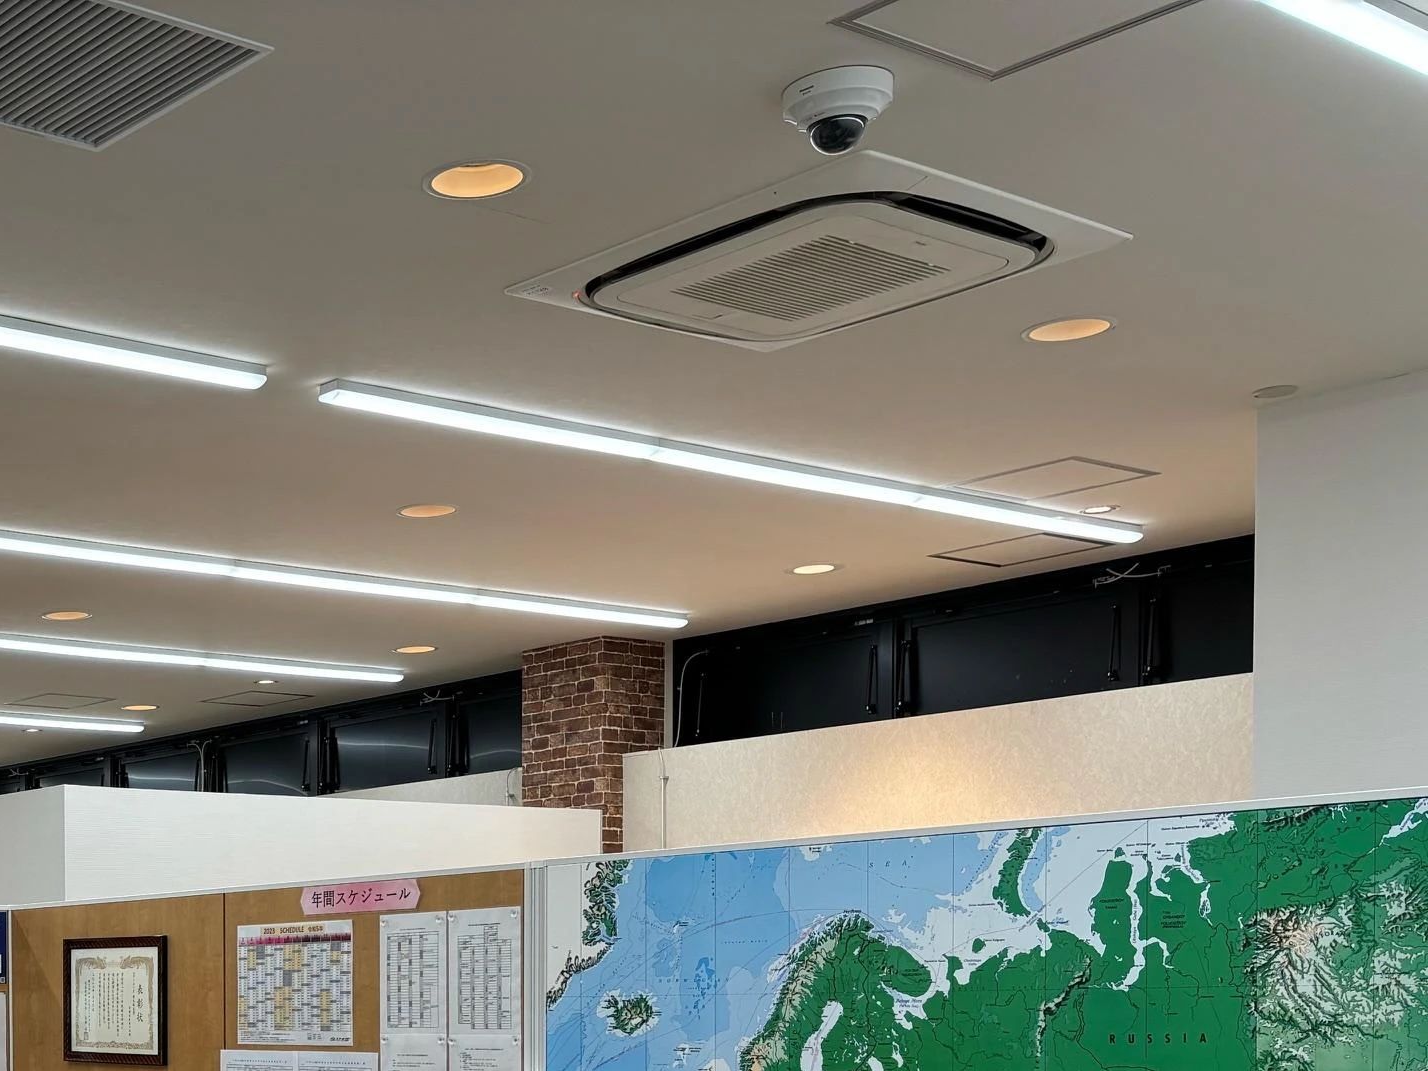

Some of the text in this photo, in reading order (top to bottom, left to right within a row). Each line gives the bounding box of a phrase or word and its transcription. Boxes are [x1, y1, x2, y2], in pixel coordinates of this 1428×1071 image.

[312, 888, 411, 908] 年間スケジュール
[280, 926, 304, 934] SCHEDULE
[1110, 1033, 1207, 1044] RUSSIA
